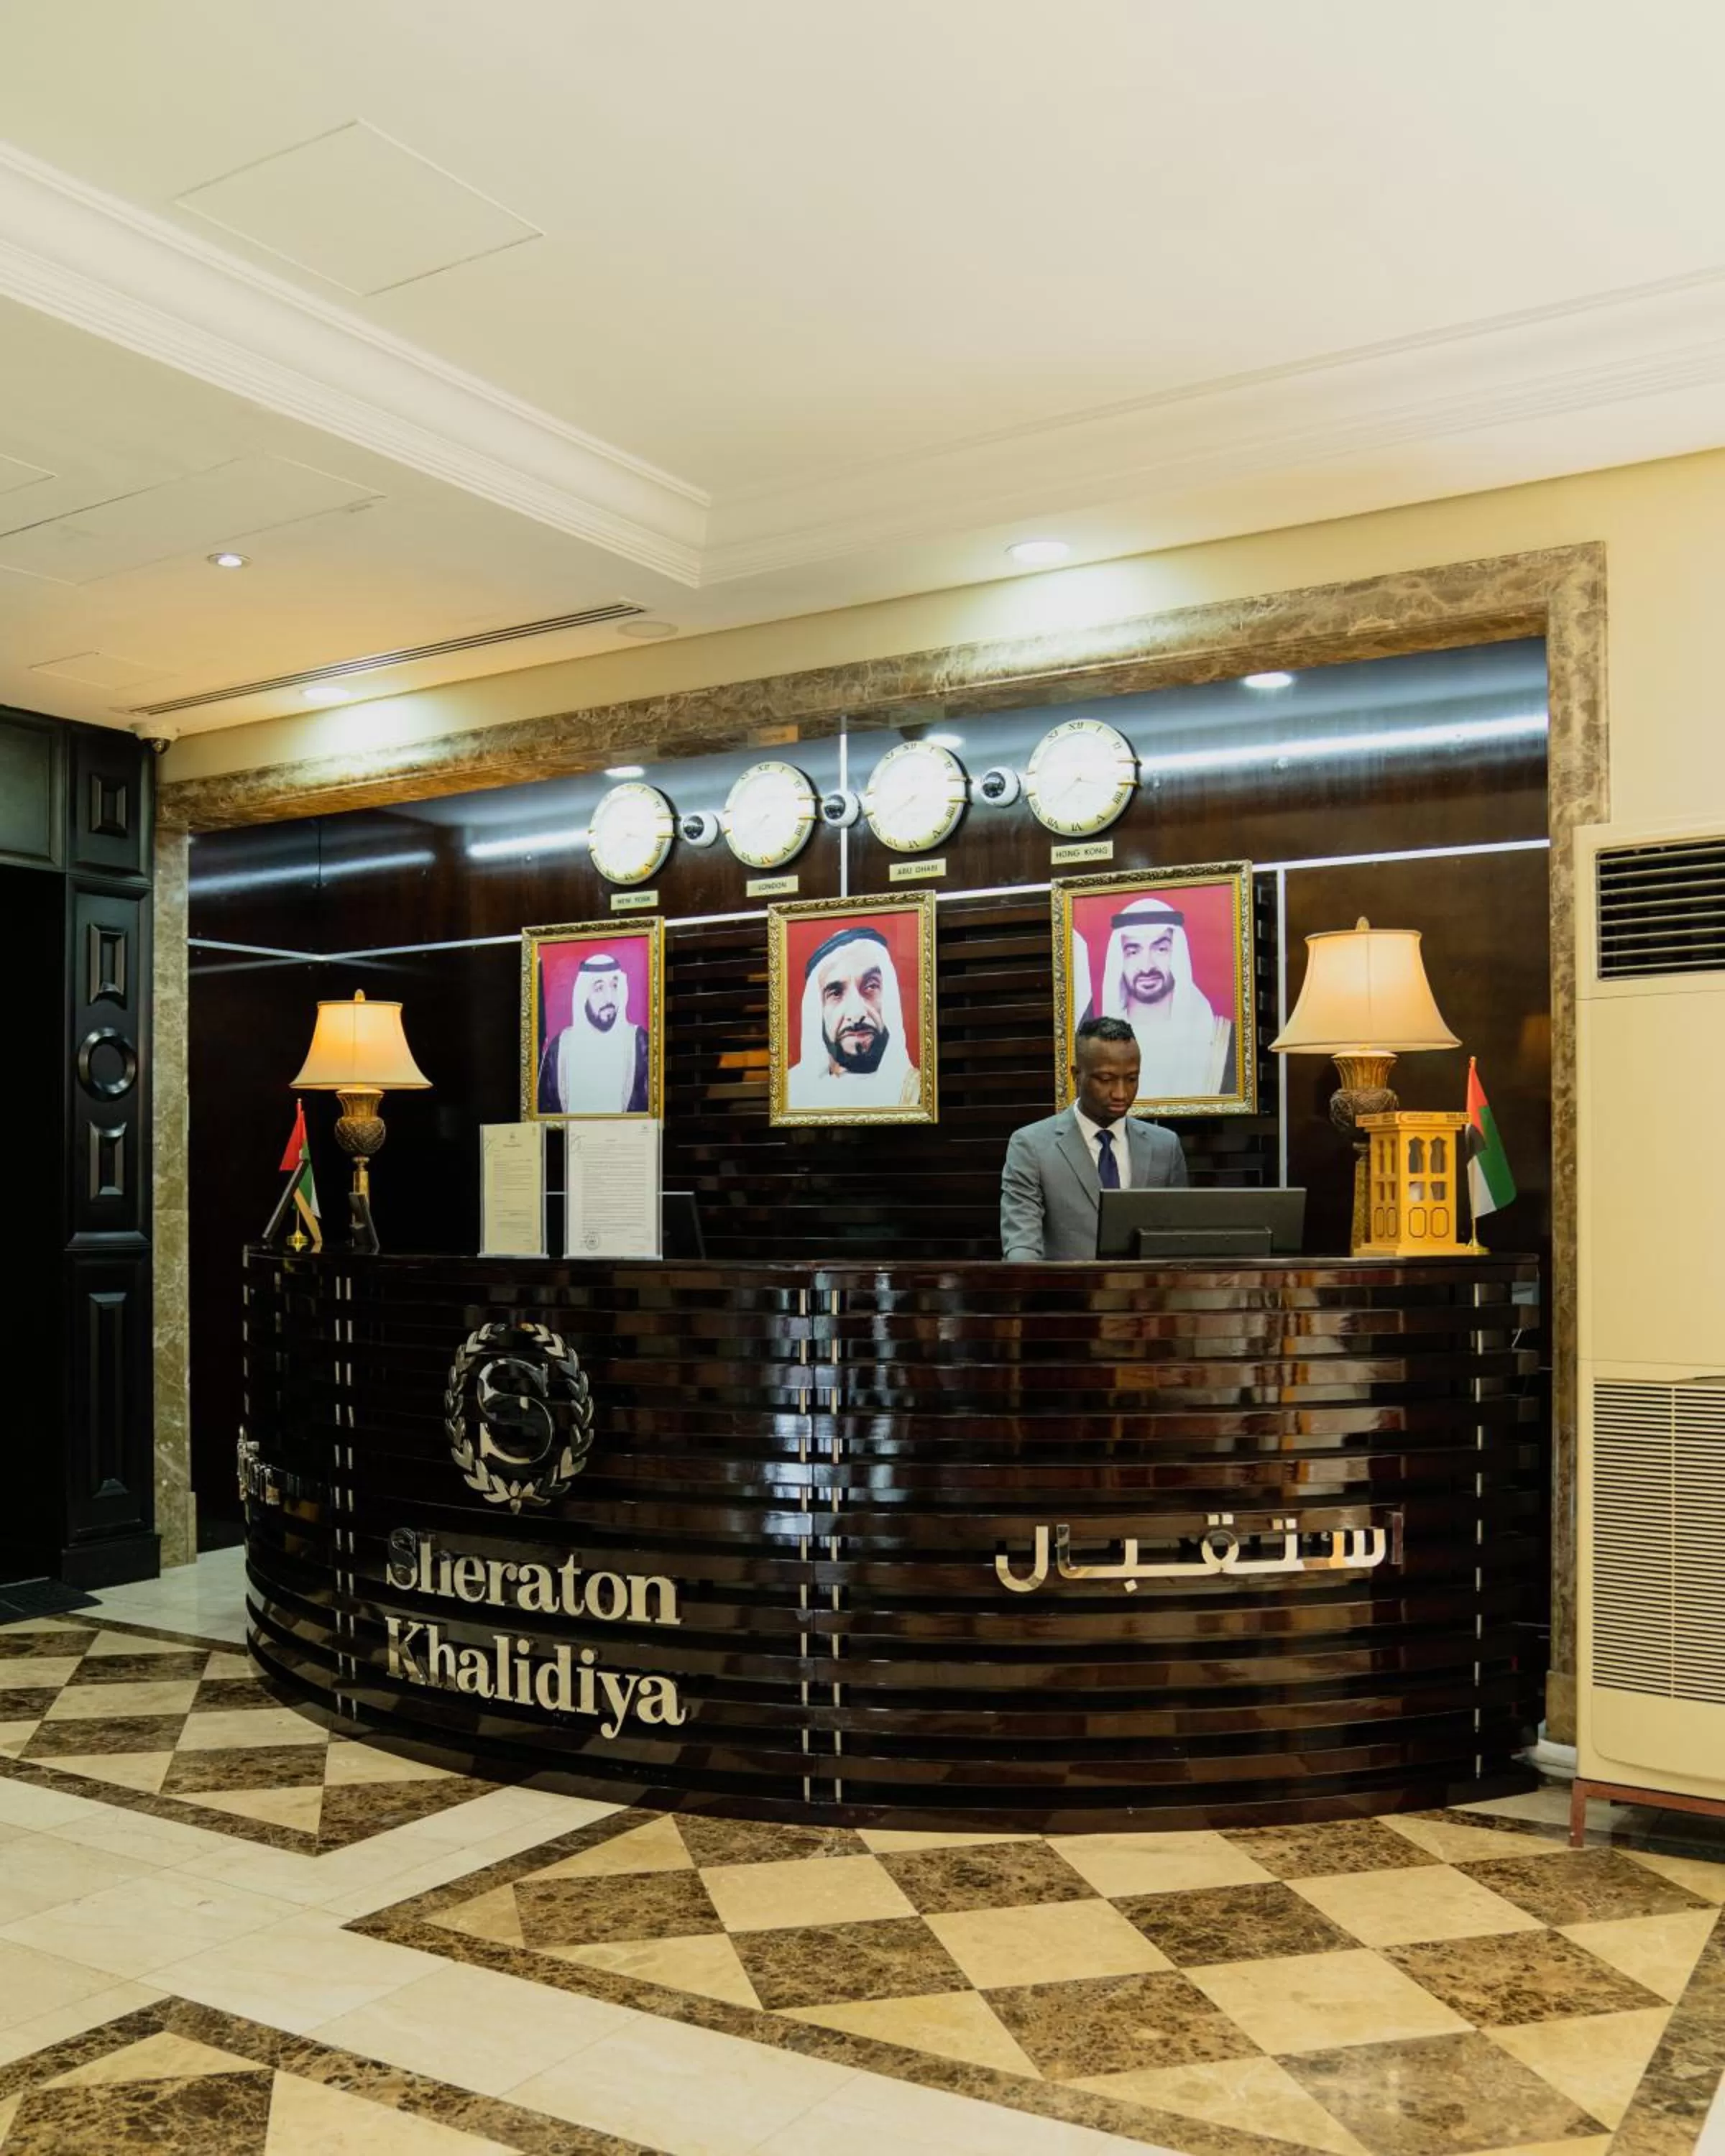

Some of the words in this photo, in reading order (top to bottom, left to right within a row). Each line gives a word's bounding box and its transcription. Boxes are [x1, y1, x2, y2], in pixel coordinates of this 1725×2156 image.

[915, 864, 938, 873] DHABI
[1056, 849, 1080, 858] HONG
[1084, 846, 1108, 856] KONG
[758, 881, 788, 890] LONDON
[995, 1511, 1404, 1593] استقبال
[386, 1527, 681, 1625] Sheraton
[385, 1615, 686, 1739] Khalidiya
